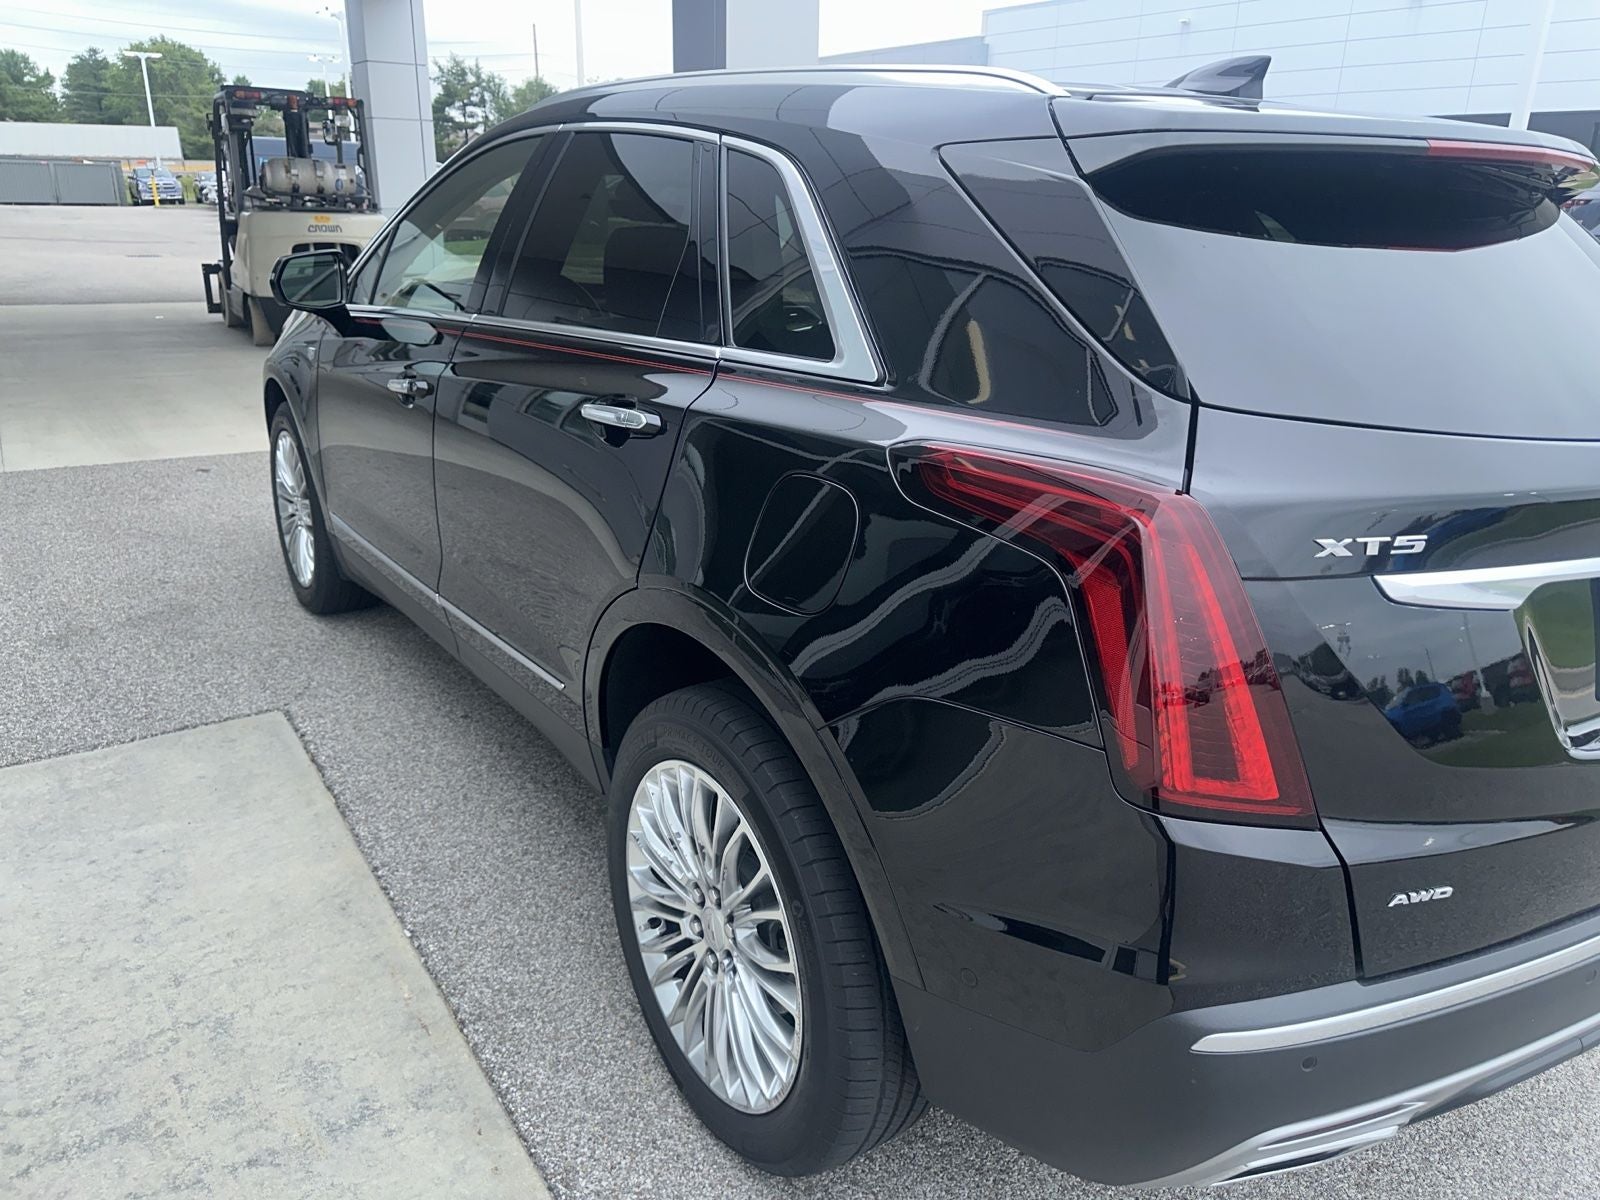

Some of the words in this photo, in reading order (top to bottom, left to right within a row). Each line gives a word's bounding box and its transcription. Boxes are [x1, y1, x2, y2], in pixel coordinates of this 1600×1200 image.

[307, 224, 343, 233] CROWN
[1313, 534, 1428, 558] XT5
[1387, 886, 1454, 907] AWD
